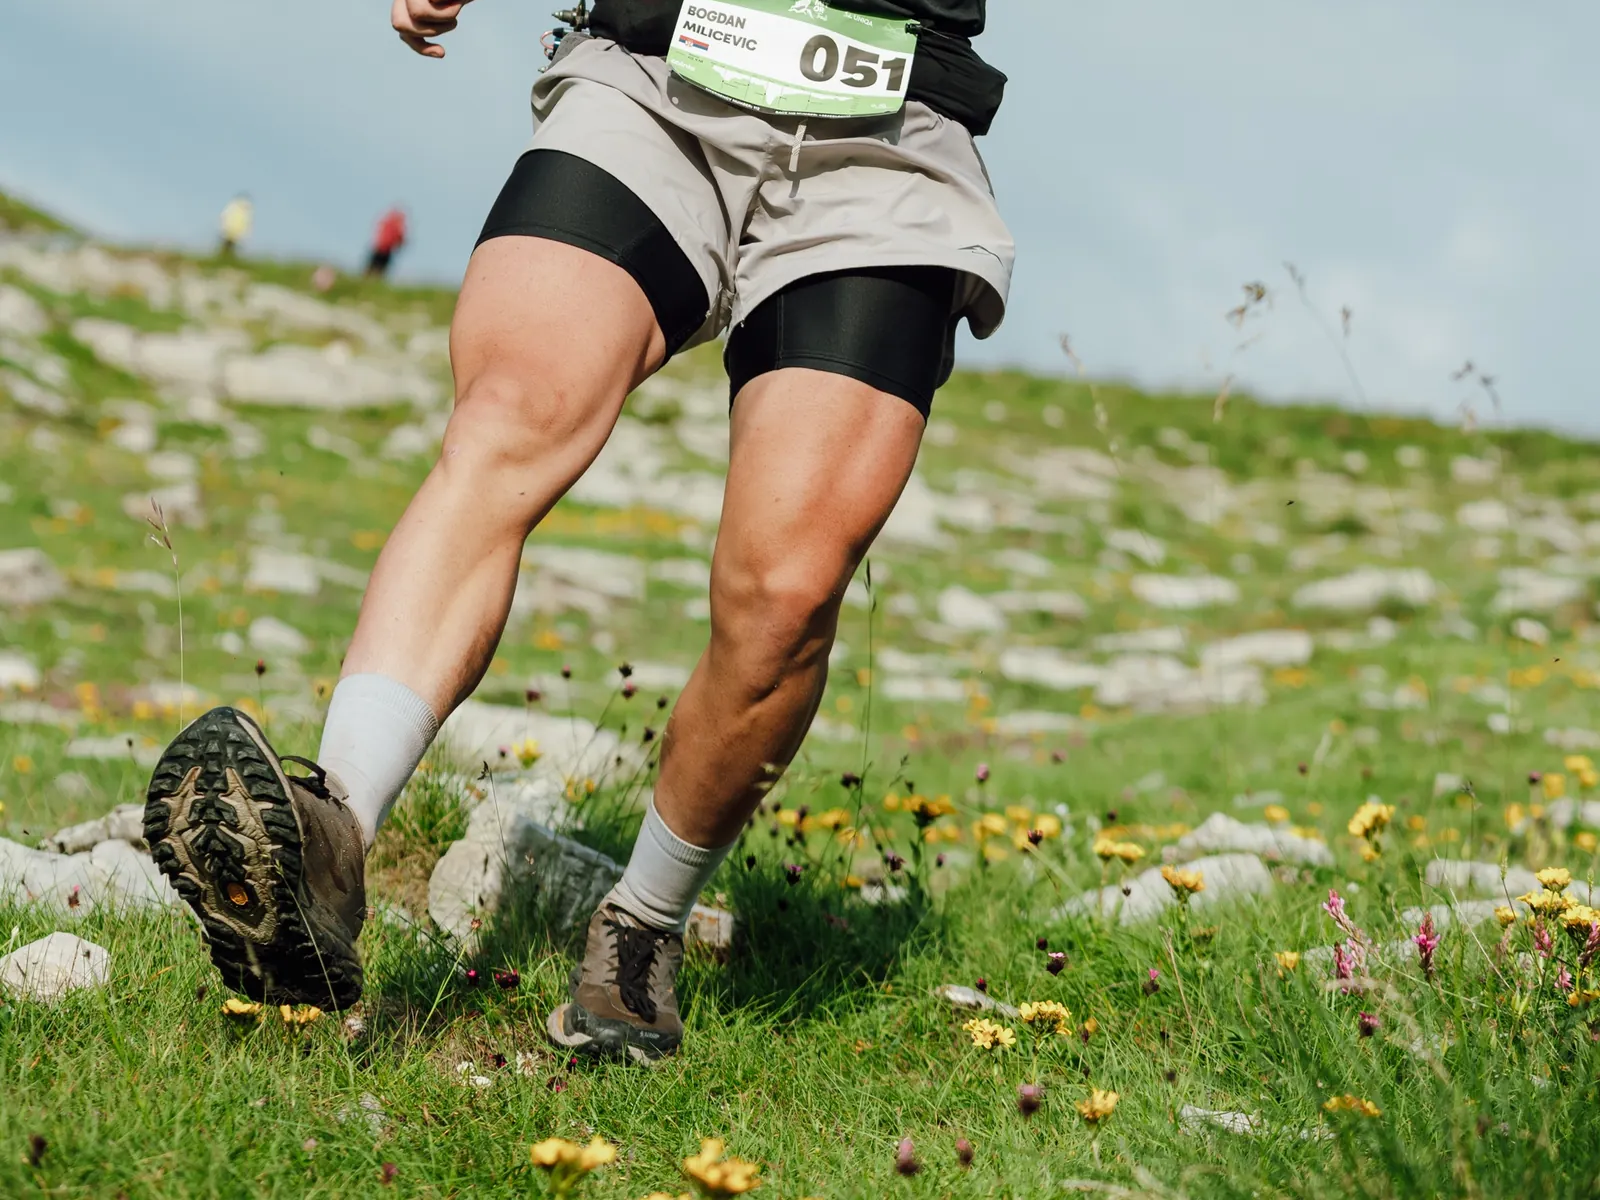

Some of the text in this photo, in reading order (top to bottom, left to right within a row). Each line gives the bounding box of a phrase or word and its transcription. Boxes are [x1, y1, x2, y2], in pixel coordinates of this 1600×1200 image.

[687, 5, 746, 29] BOGDAN
[683, 20, 758, 51] MILICEVIC
[800, 34, 907, 92] 051
